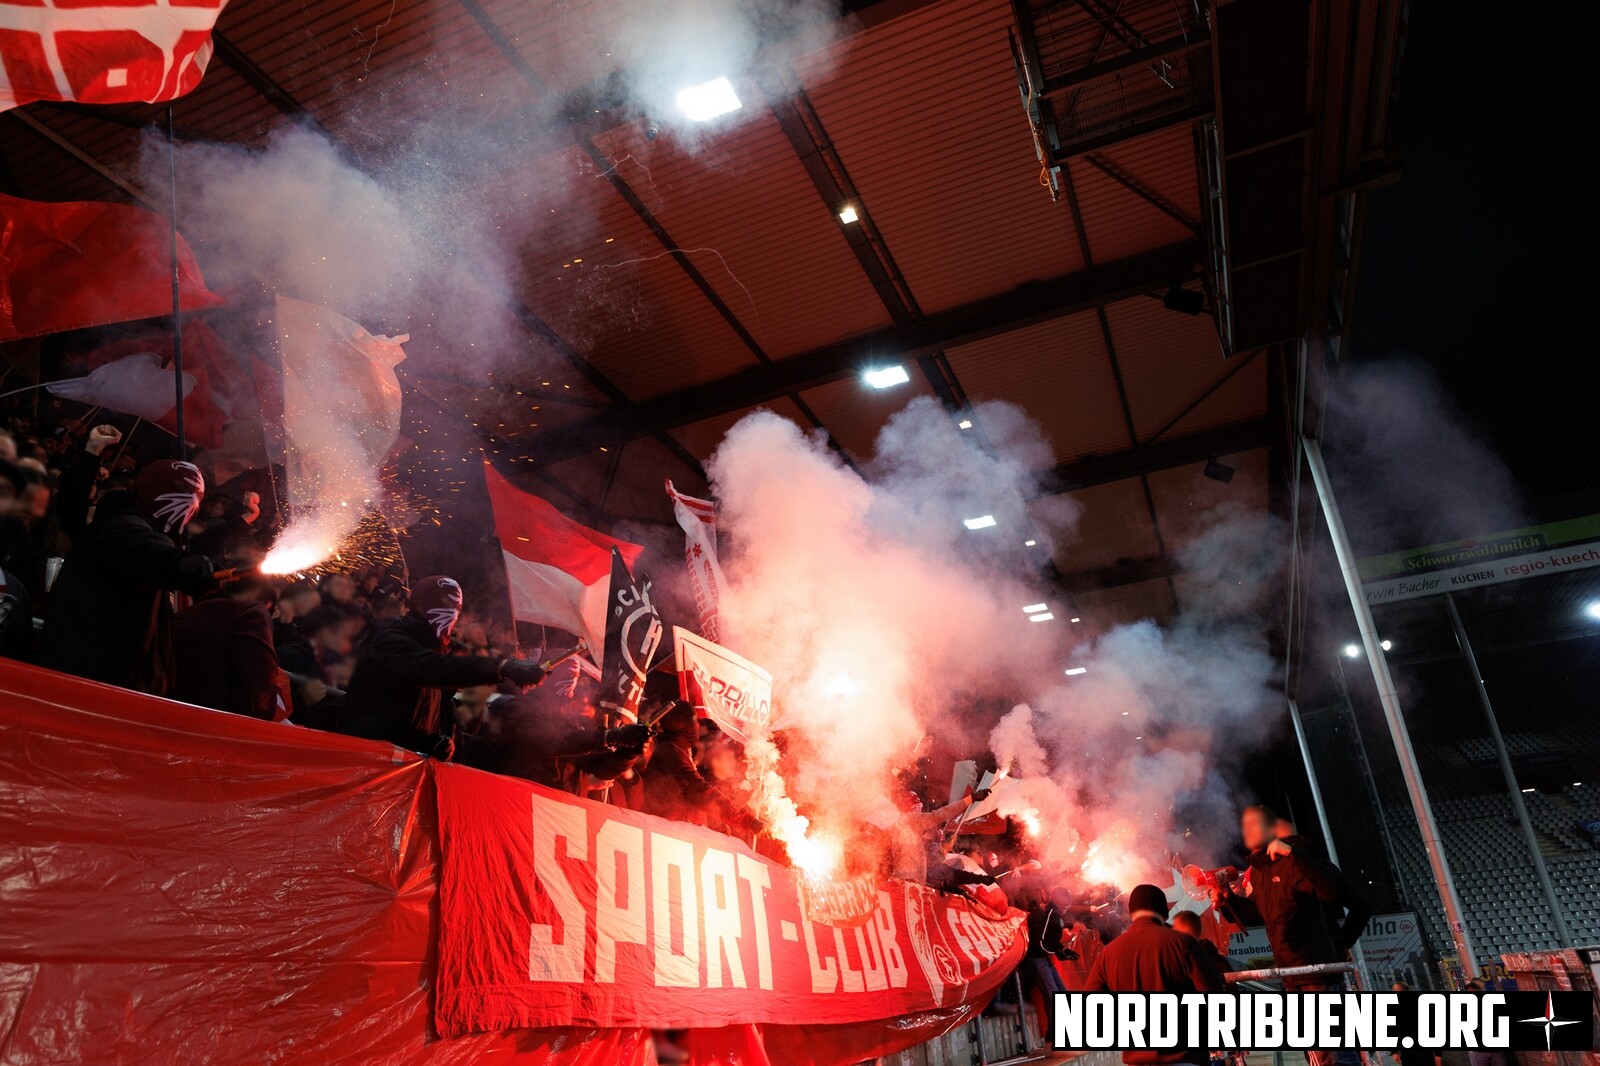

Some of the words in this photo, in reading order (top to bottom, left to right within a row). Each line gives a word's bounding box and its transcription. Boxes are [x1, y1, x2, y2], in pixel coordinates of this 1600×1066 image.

[1407, 535, 1541, 570] Schwarzwaldmilch
[1367, 586, 1394, 601] rwin
[1398, 577, 1441, 595] Bucher
[1451, 570, 1495, 585] KÜCHEN
[1366, 917, 1397, 937] iha
[1228, 944, 1272, 956] hraubend
